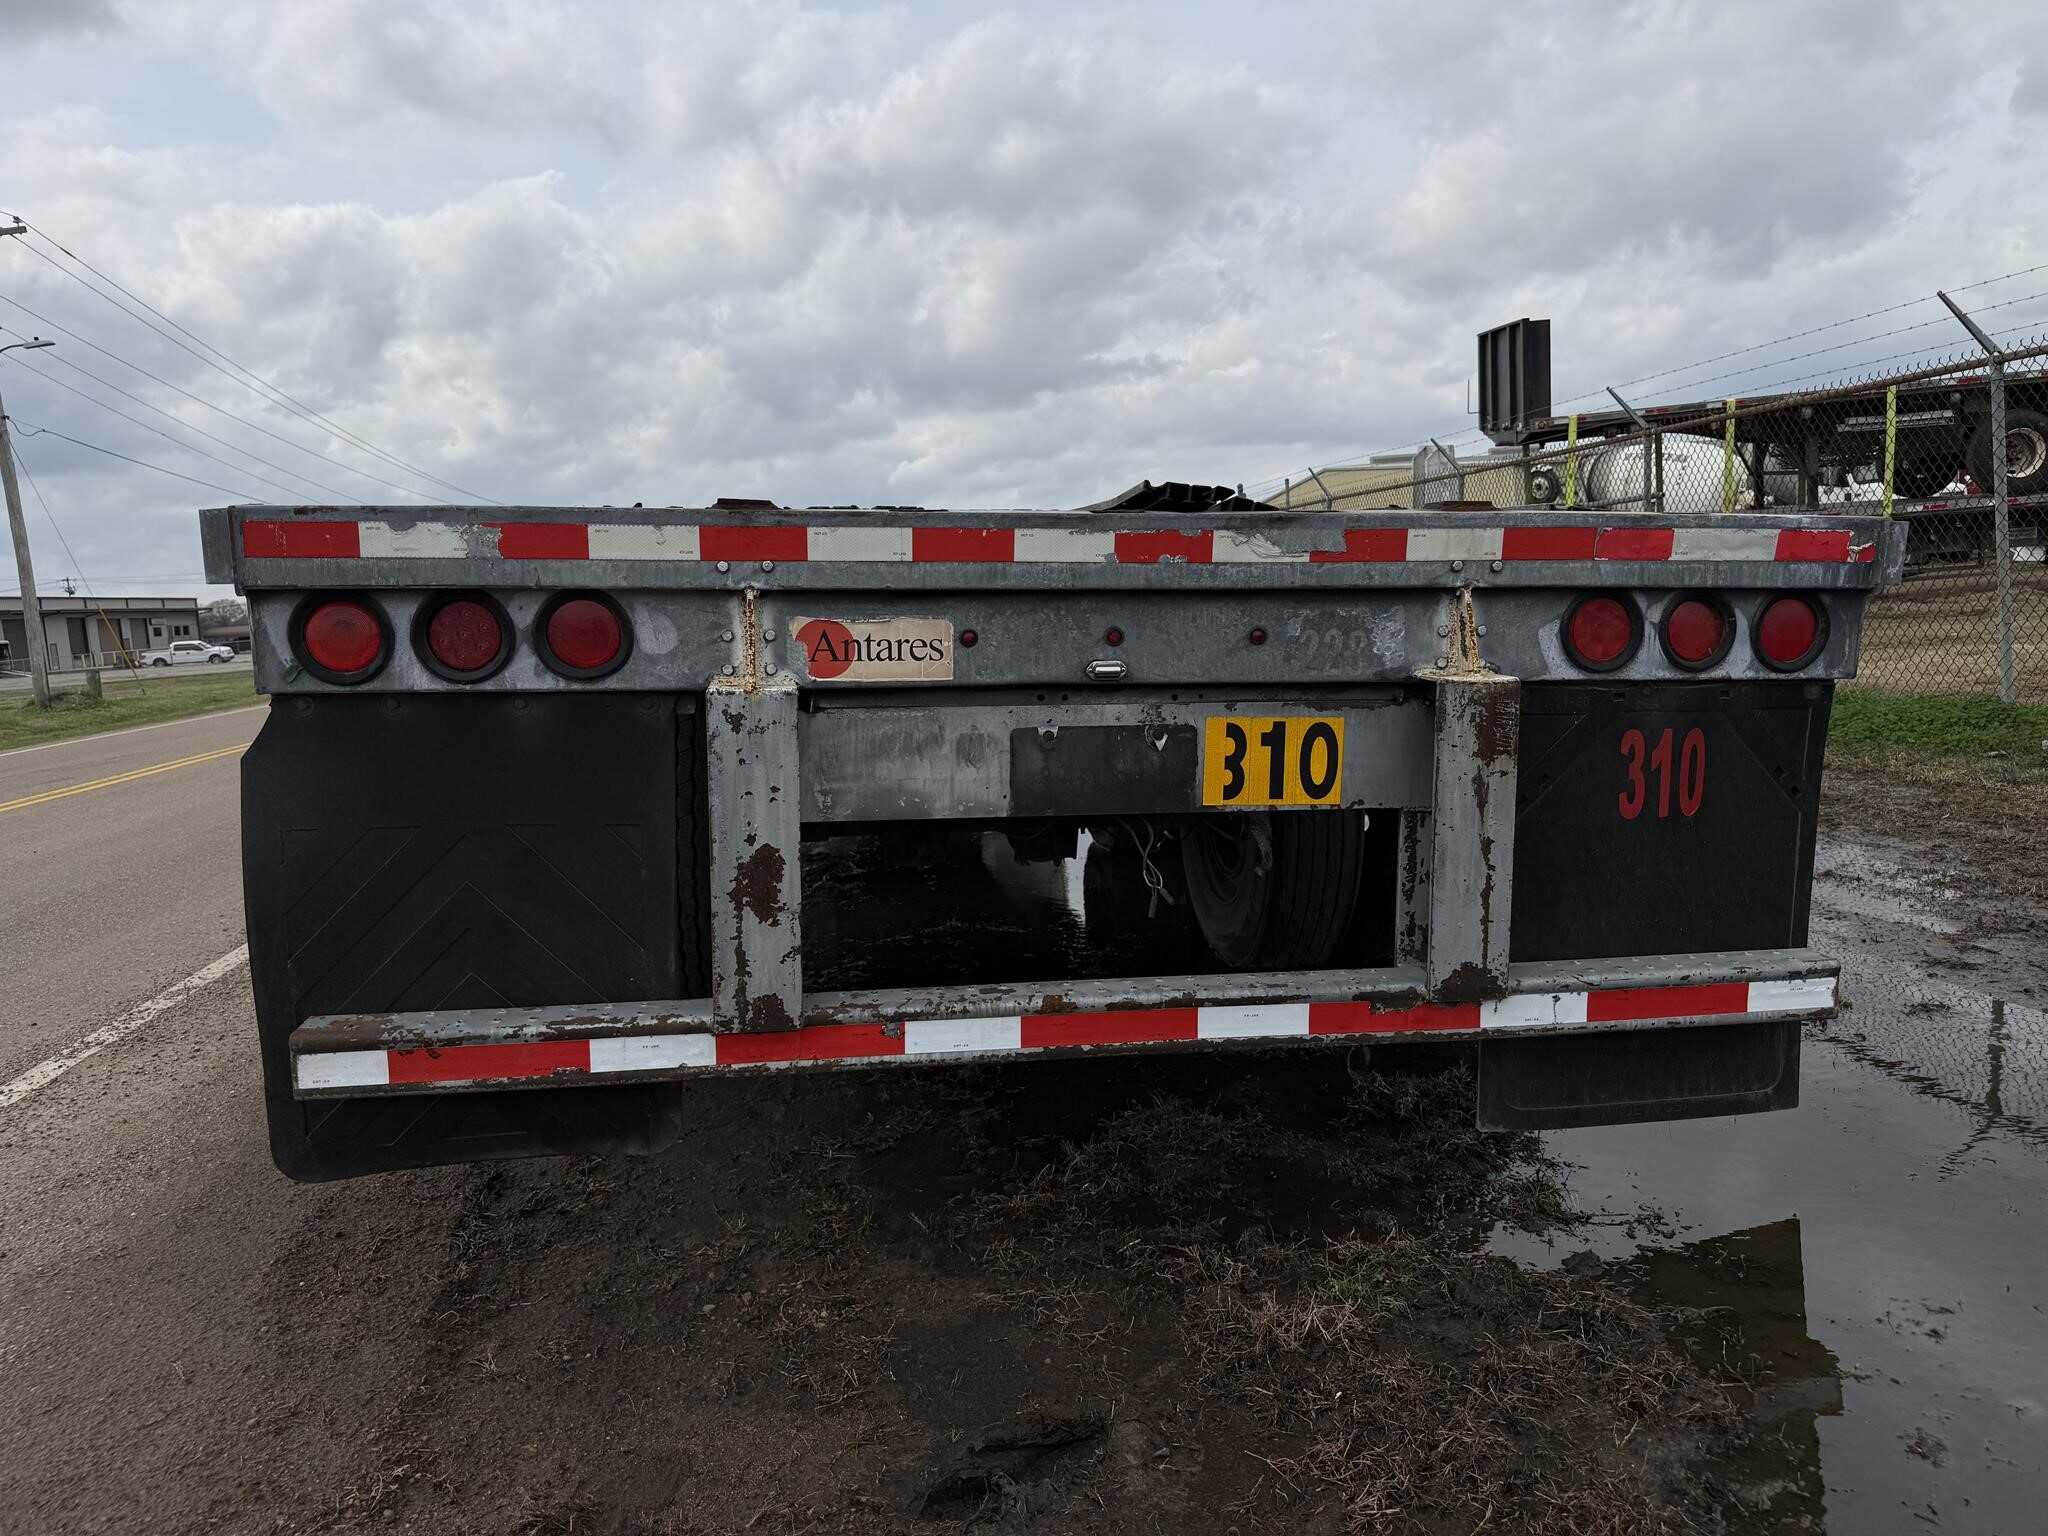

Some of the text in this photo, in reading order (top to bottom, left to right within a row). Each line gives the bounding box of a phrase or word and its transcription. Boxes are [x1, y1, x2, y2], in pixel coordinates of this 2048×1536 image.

[808, 629, 944, 662] Antares
[1222, 721, 1339, 801] 310
[1618, 727, 1707, 820] 310
